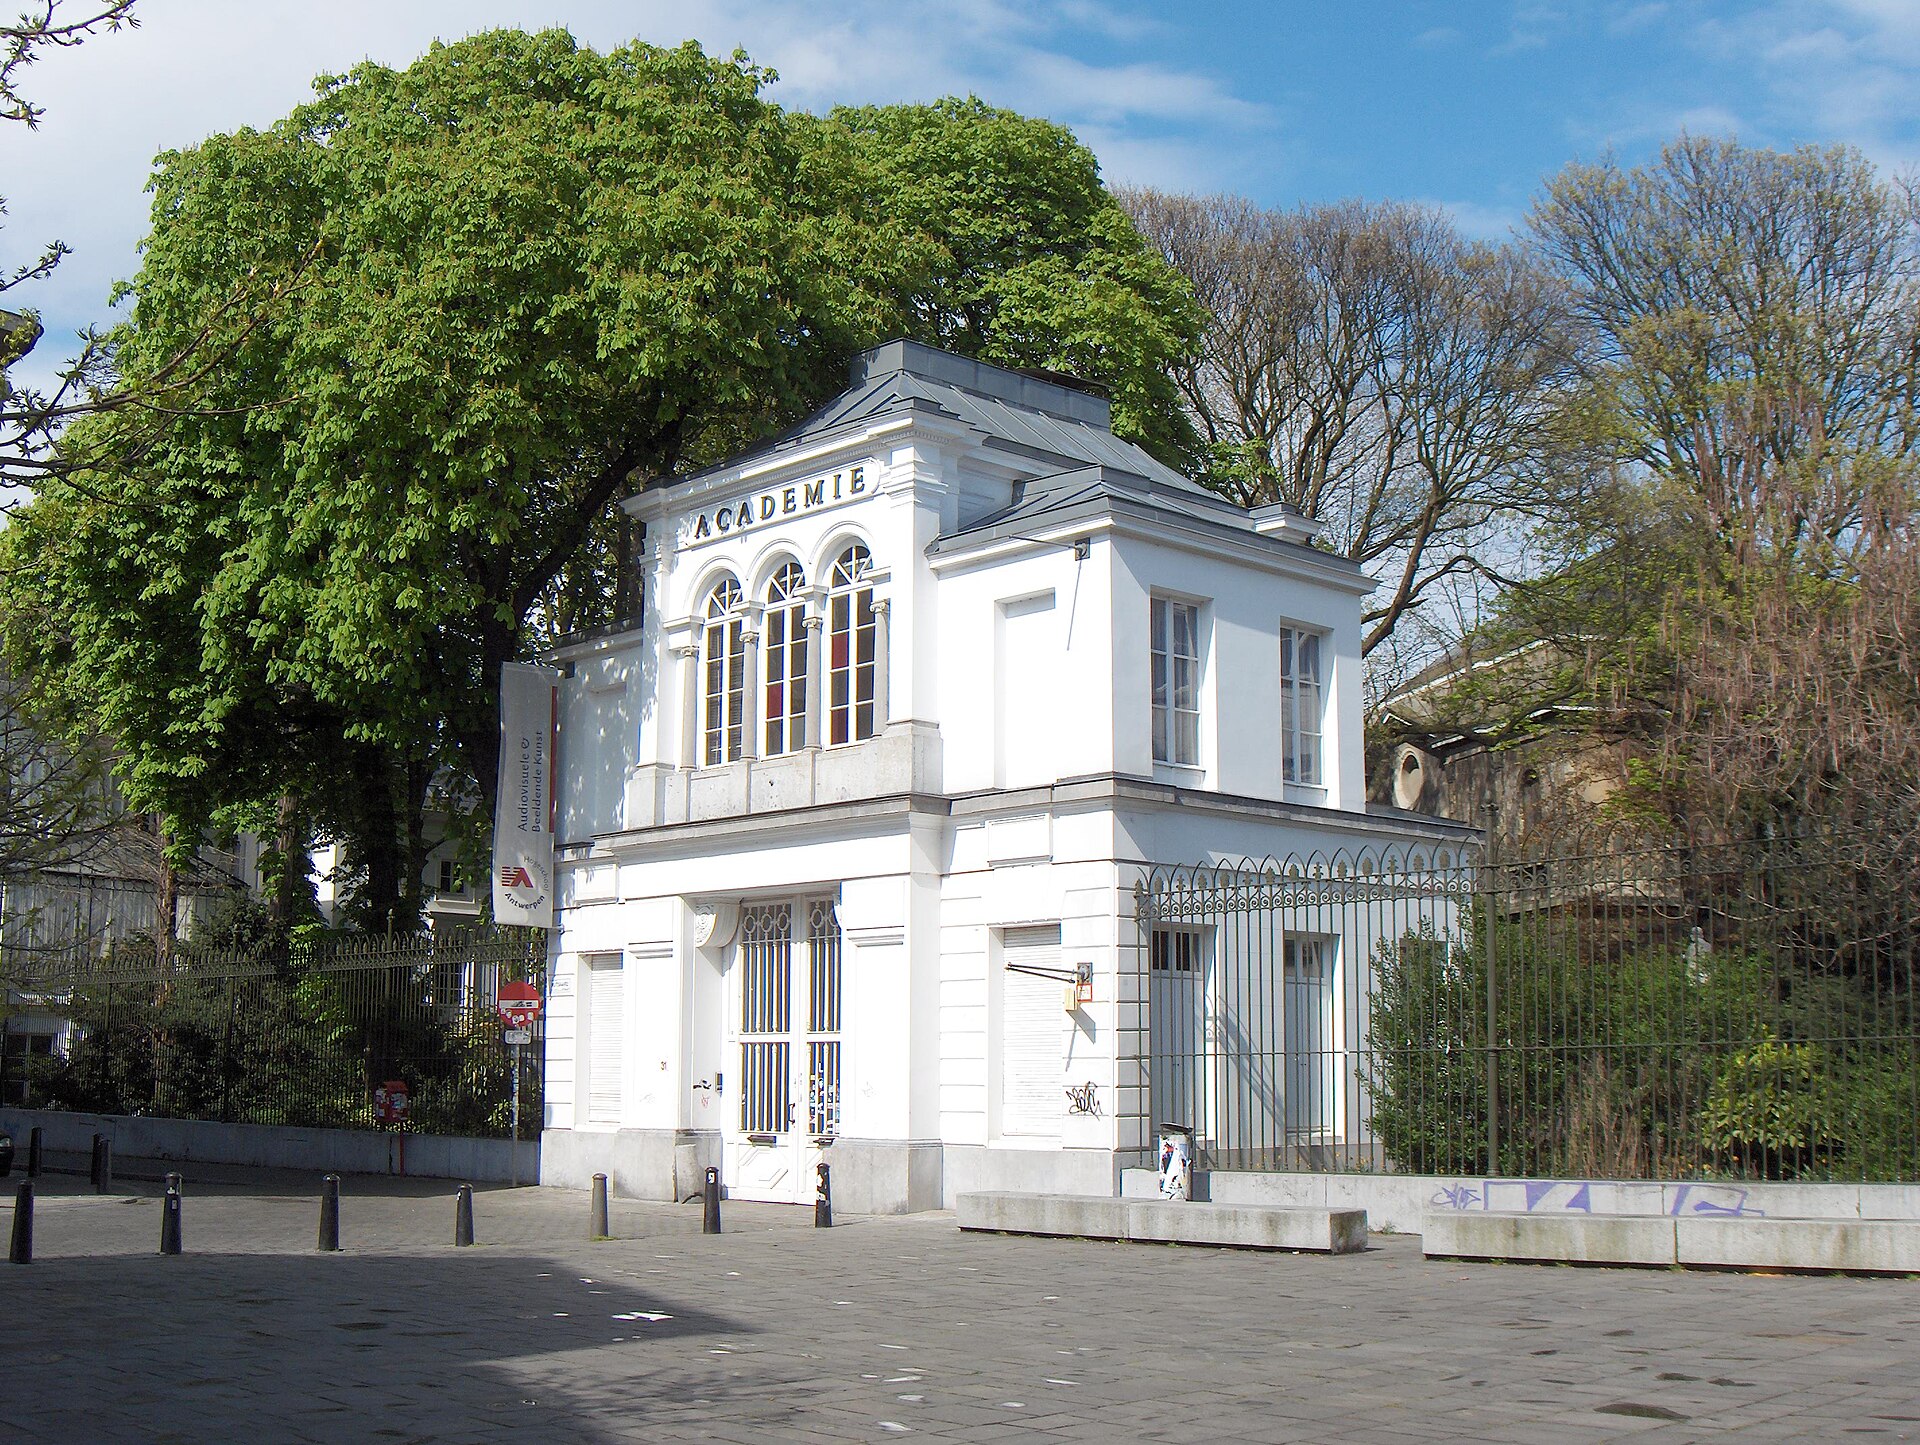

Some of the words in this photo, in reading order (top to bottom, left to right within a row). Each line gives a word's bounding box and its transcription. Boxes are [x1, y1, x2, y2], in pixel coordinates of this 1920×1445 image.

[695, 466, 866, 539] ACADEMIE
[533, 731, 543, 765] Kunst
[518, 753, 530, 832] Audiovisuele
[532, 769, 542, 833] Beeldende
[523, 855, 549, 892] Hogeschool
[504, 892, 546, 910] Antwerpen
